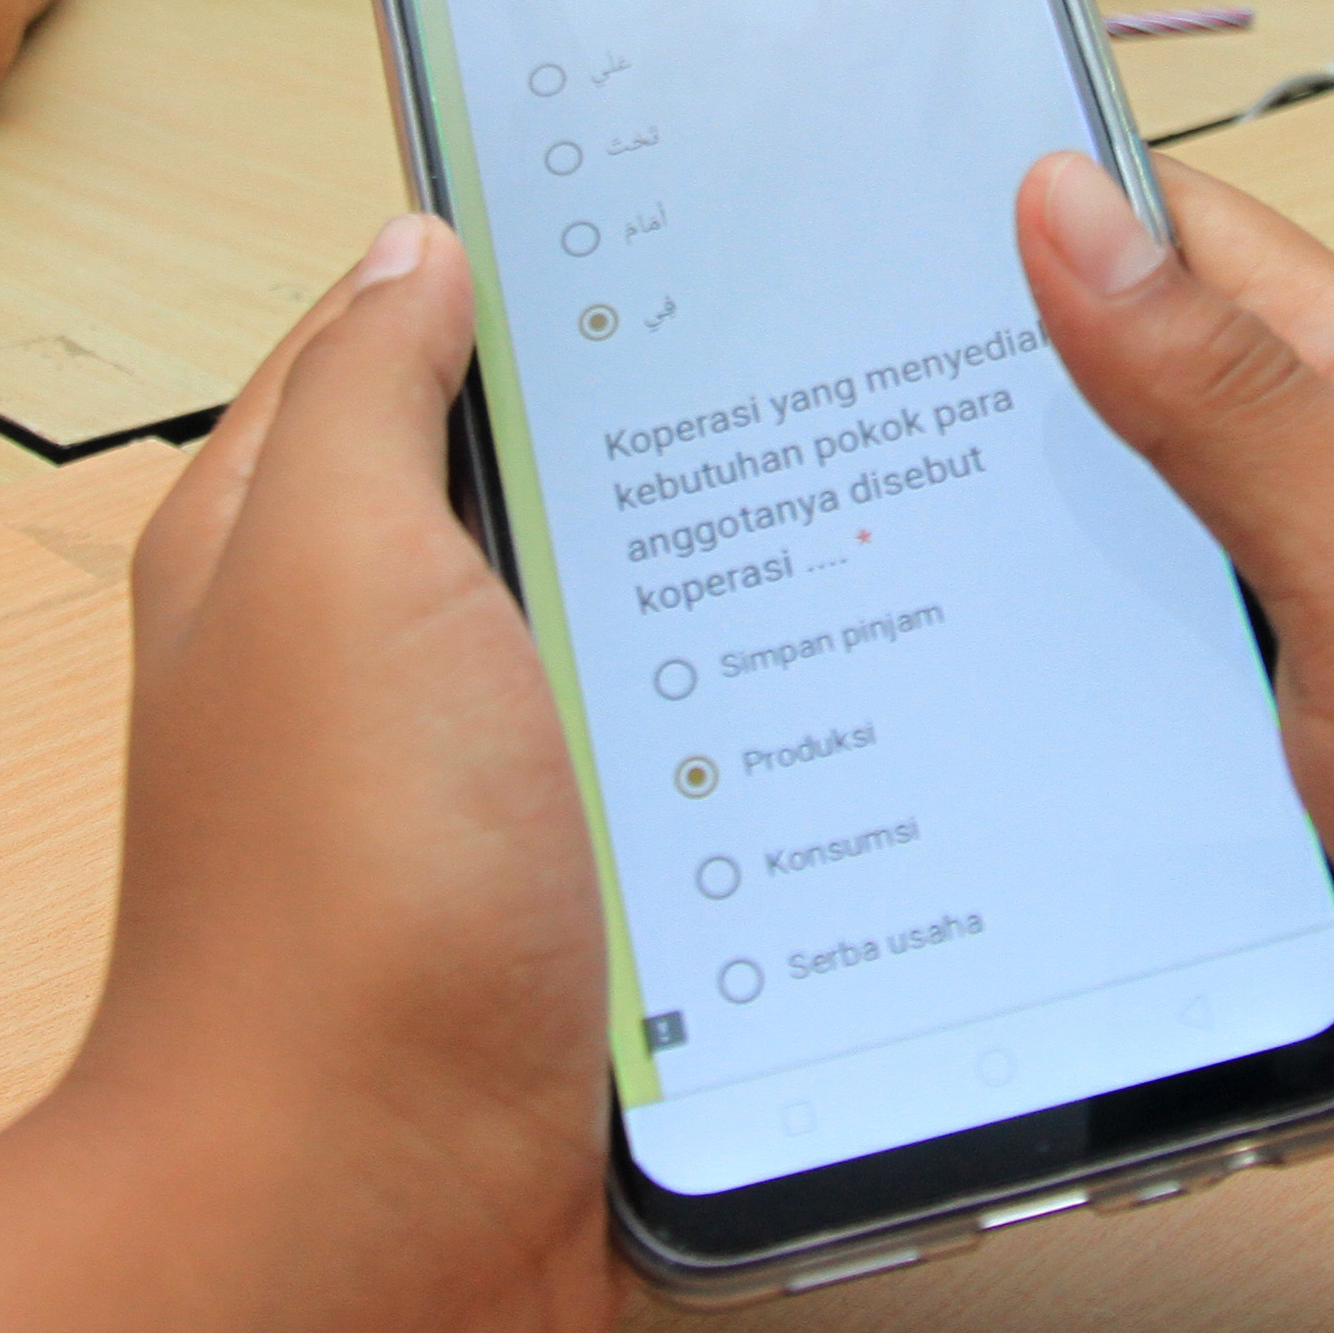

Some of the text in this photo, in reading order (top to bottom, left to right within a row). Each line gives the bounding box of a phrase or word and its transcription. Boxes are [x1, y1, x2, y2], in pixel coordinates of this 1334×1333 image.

[604, 397, 762, 460] Koperasi
[770, 376, 857, 425] yang
[613, 388, 1015, 511] kebutuhan pokok para
[626, 446, 986, 567] anggotanya disebut
[635, 550, 795, 616] koperasi
[719, 600, 946, 682] Simpan pinjam
[742, 721, 878, 778] Produksi
[764, 817, 921, 879] Konsumsi
[787, 909, 985, 983] Serba usaha
